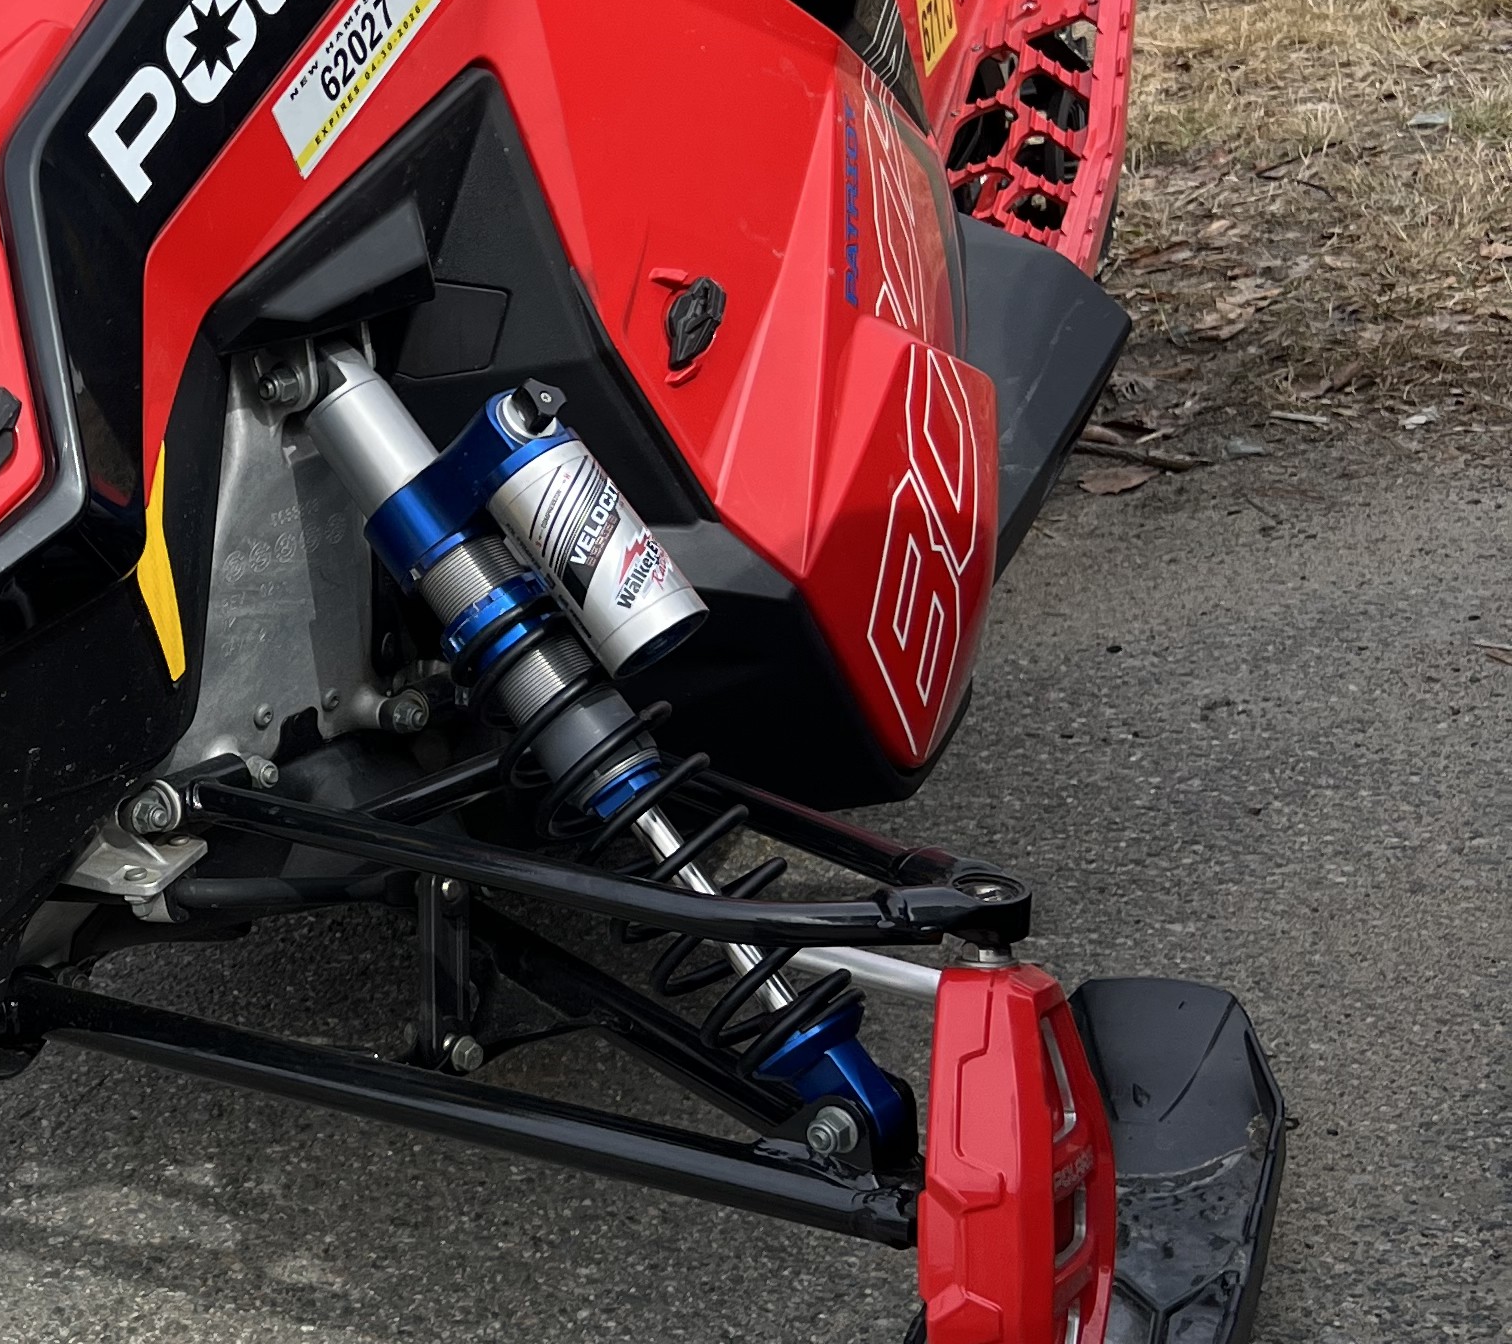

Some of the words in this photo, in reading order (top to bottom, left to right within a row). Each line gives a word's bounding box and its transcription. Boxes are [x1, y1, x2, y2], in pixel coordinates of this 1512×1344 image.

[290, 60, 319, 101] NEW
[315, 86, 360, 145] EXPIRES
[844, 94, 859, 308] PATRIOT
